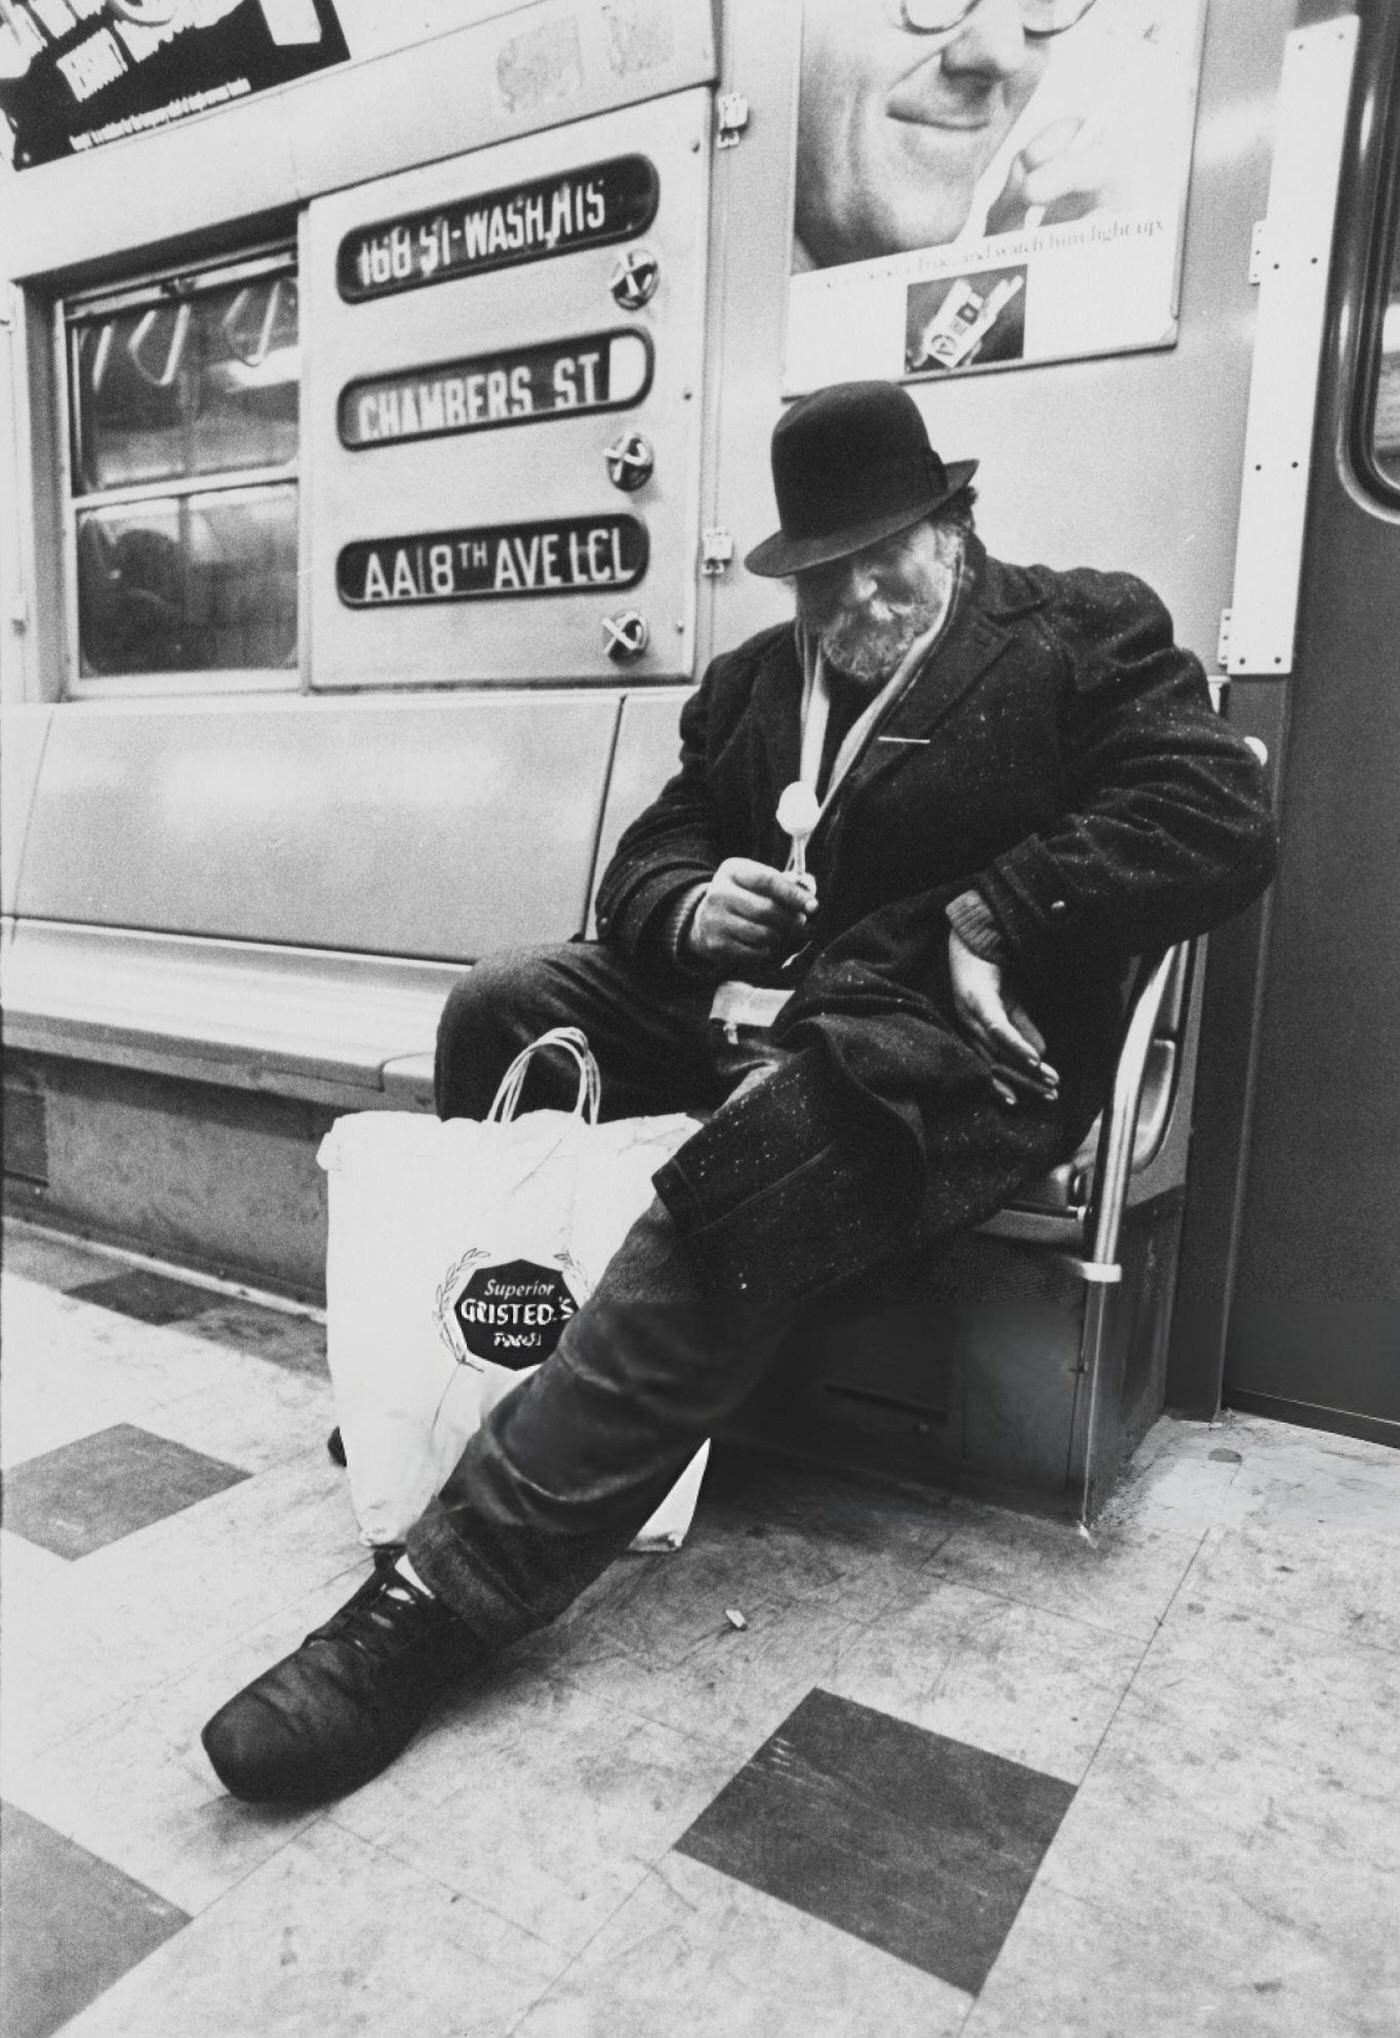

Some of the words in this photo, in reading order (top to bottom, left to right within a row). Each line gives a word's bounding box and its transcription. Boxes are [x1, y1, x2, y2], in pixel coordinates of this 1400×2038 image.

[358, 366, 533, 440] CHAMBERS
[553, 352, 600, 408] ST
[494, 533, 561, 589] AVE
[570, 528, 634, 584] LCL
[484, 1278, 555, 1301] Superior
